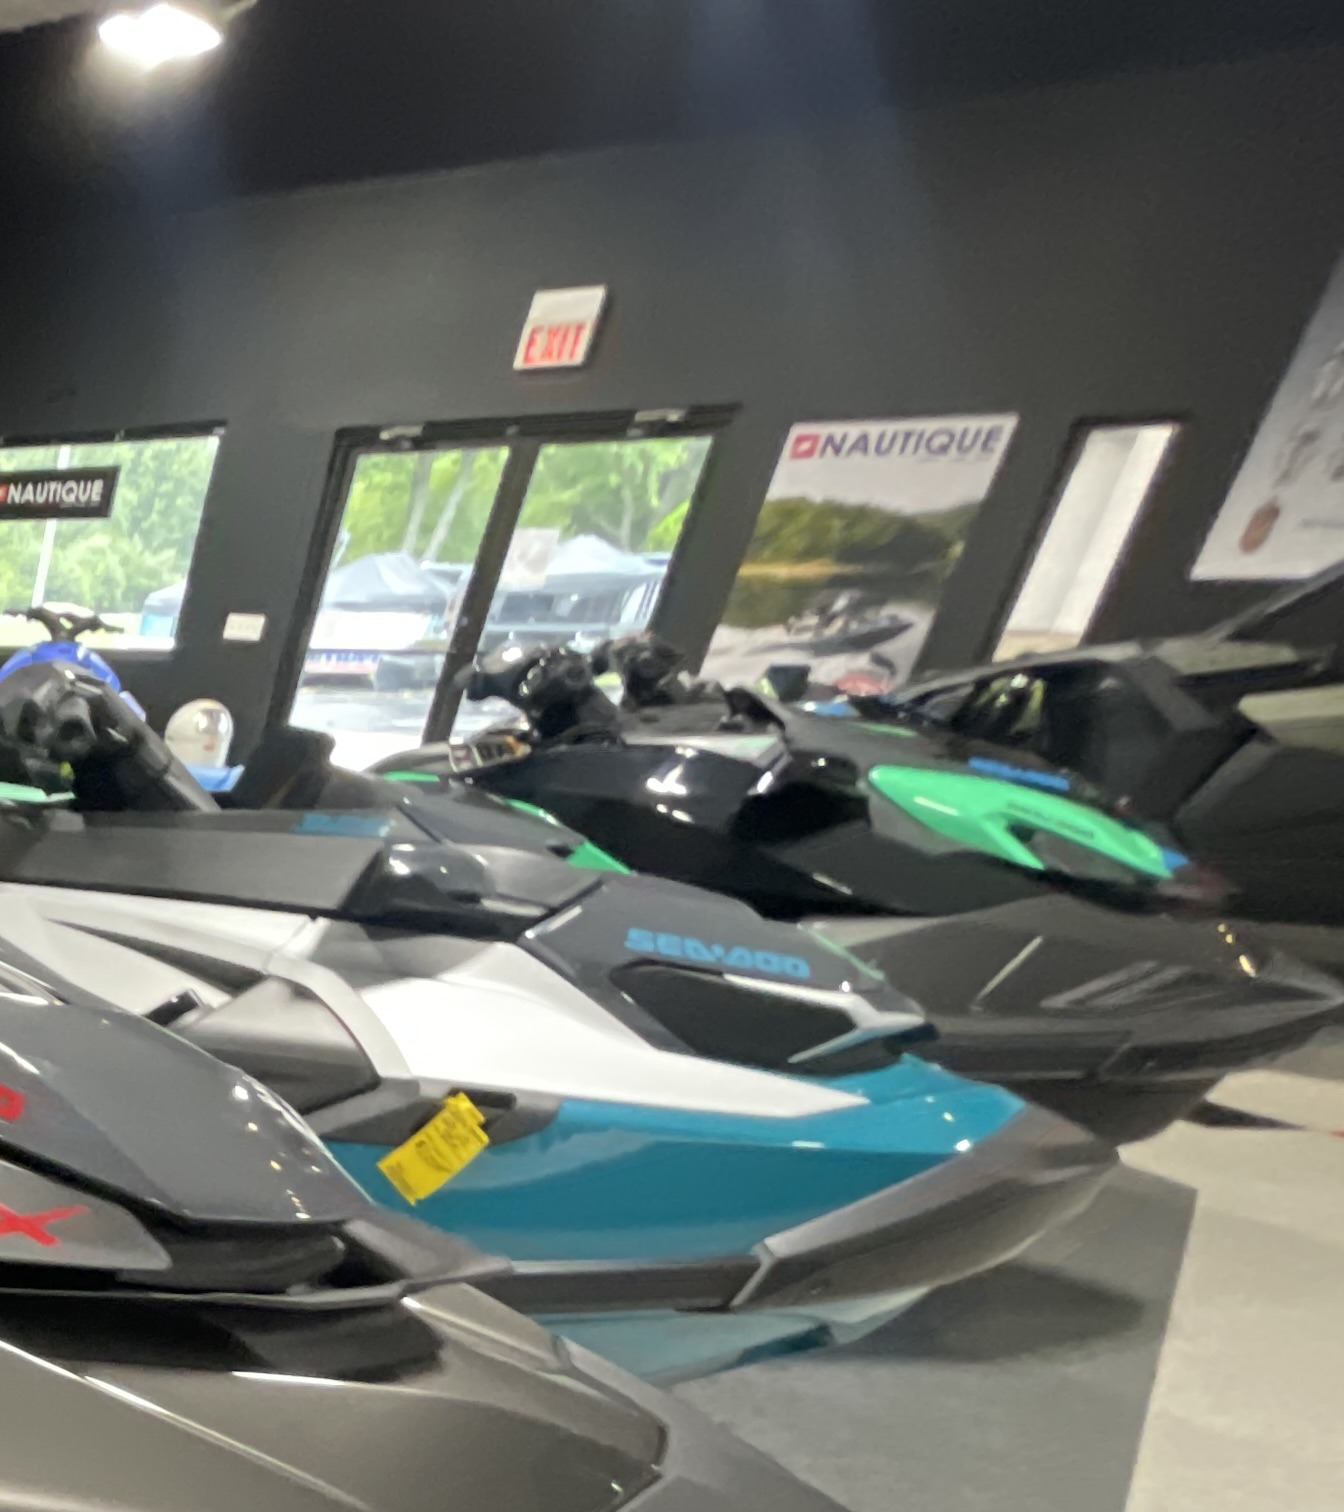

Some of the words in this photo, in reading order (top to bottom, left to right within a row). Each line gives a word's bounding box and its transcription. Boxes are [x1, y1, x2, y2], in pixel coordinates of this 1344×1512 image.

[523, 322, 586, 365] EXIT
[819, 425, 1005, 459] NAUTIQUE
[7, 479, 104, 504] NAUTIQUE
